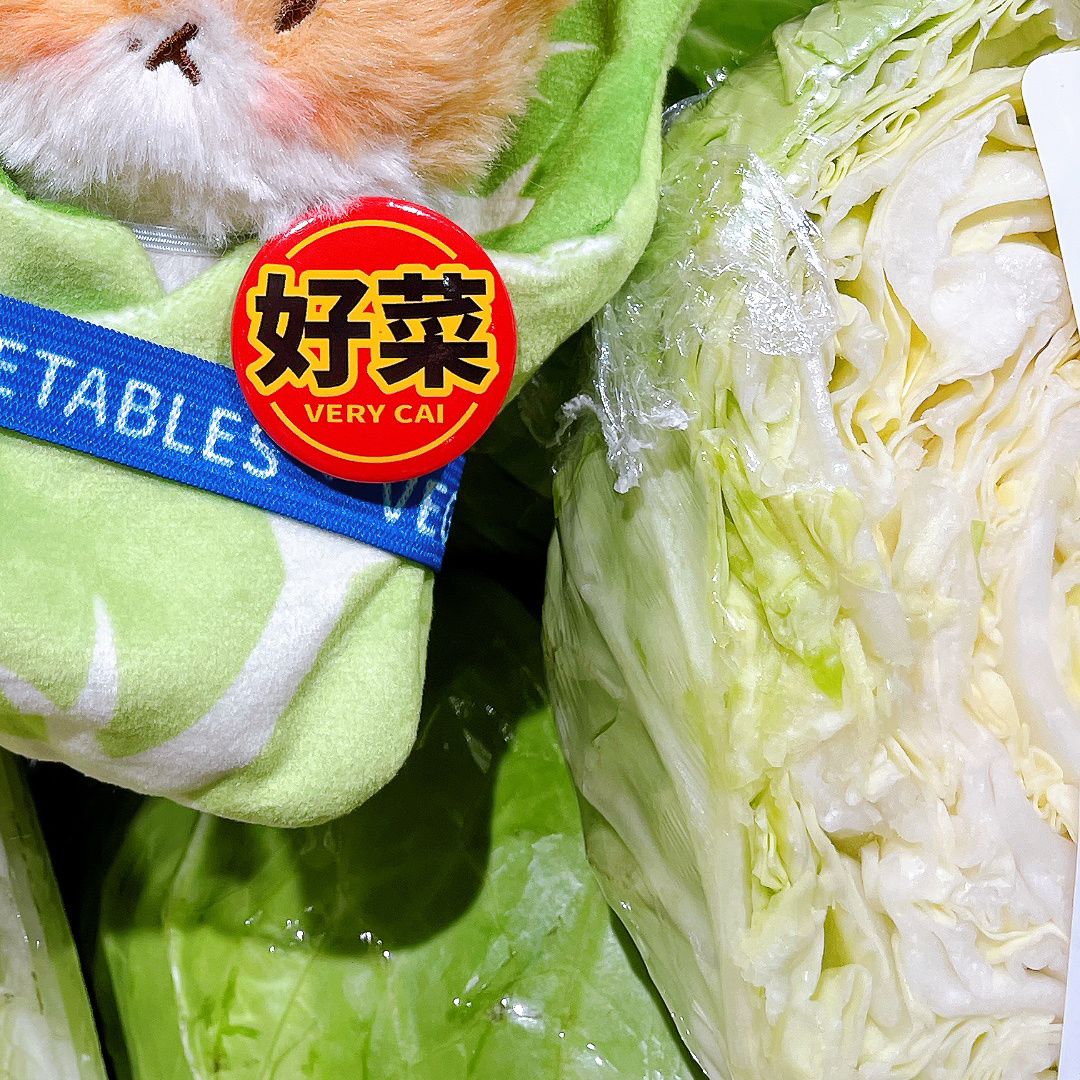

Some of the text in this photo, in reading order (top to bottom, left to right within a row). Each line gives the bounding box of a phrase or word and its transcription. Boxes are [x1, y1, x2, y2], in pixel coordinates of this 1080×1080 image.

[250, 268, 494, 393] 好菜
[304, 403, 444, 424] VERY CAI
